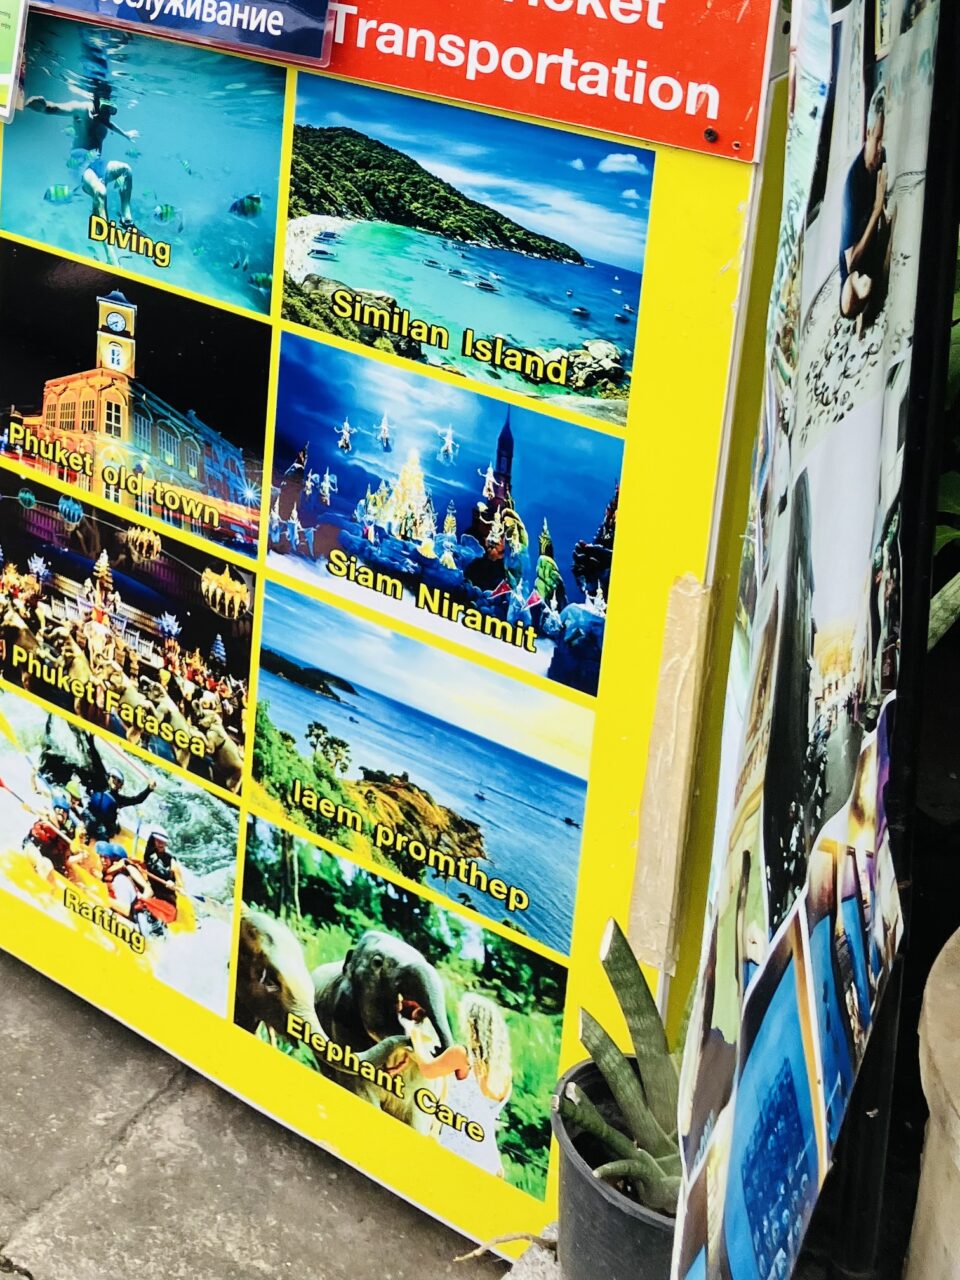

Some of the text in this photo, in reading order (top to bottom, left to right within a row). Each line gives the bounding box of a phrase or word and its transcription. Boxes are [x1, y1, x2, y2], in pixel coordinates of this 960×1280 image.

[326, 1, 720, 119] Transportation
[88, 214, 173, 269] Diving
[332, 289, 569, 388] Similan Island
[7, 421, 222, 529] Phuket old town
[326, 547, 539, 655] Siam Niramit
[11, 642, 206, 761] Phuket Fatasea
[62, 887, 146, 956] Rafting
[374, 824, 530, 914] promthep
[286, 1011, 486, 1145] Elephant Care
